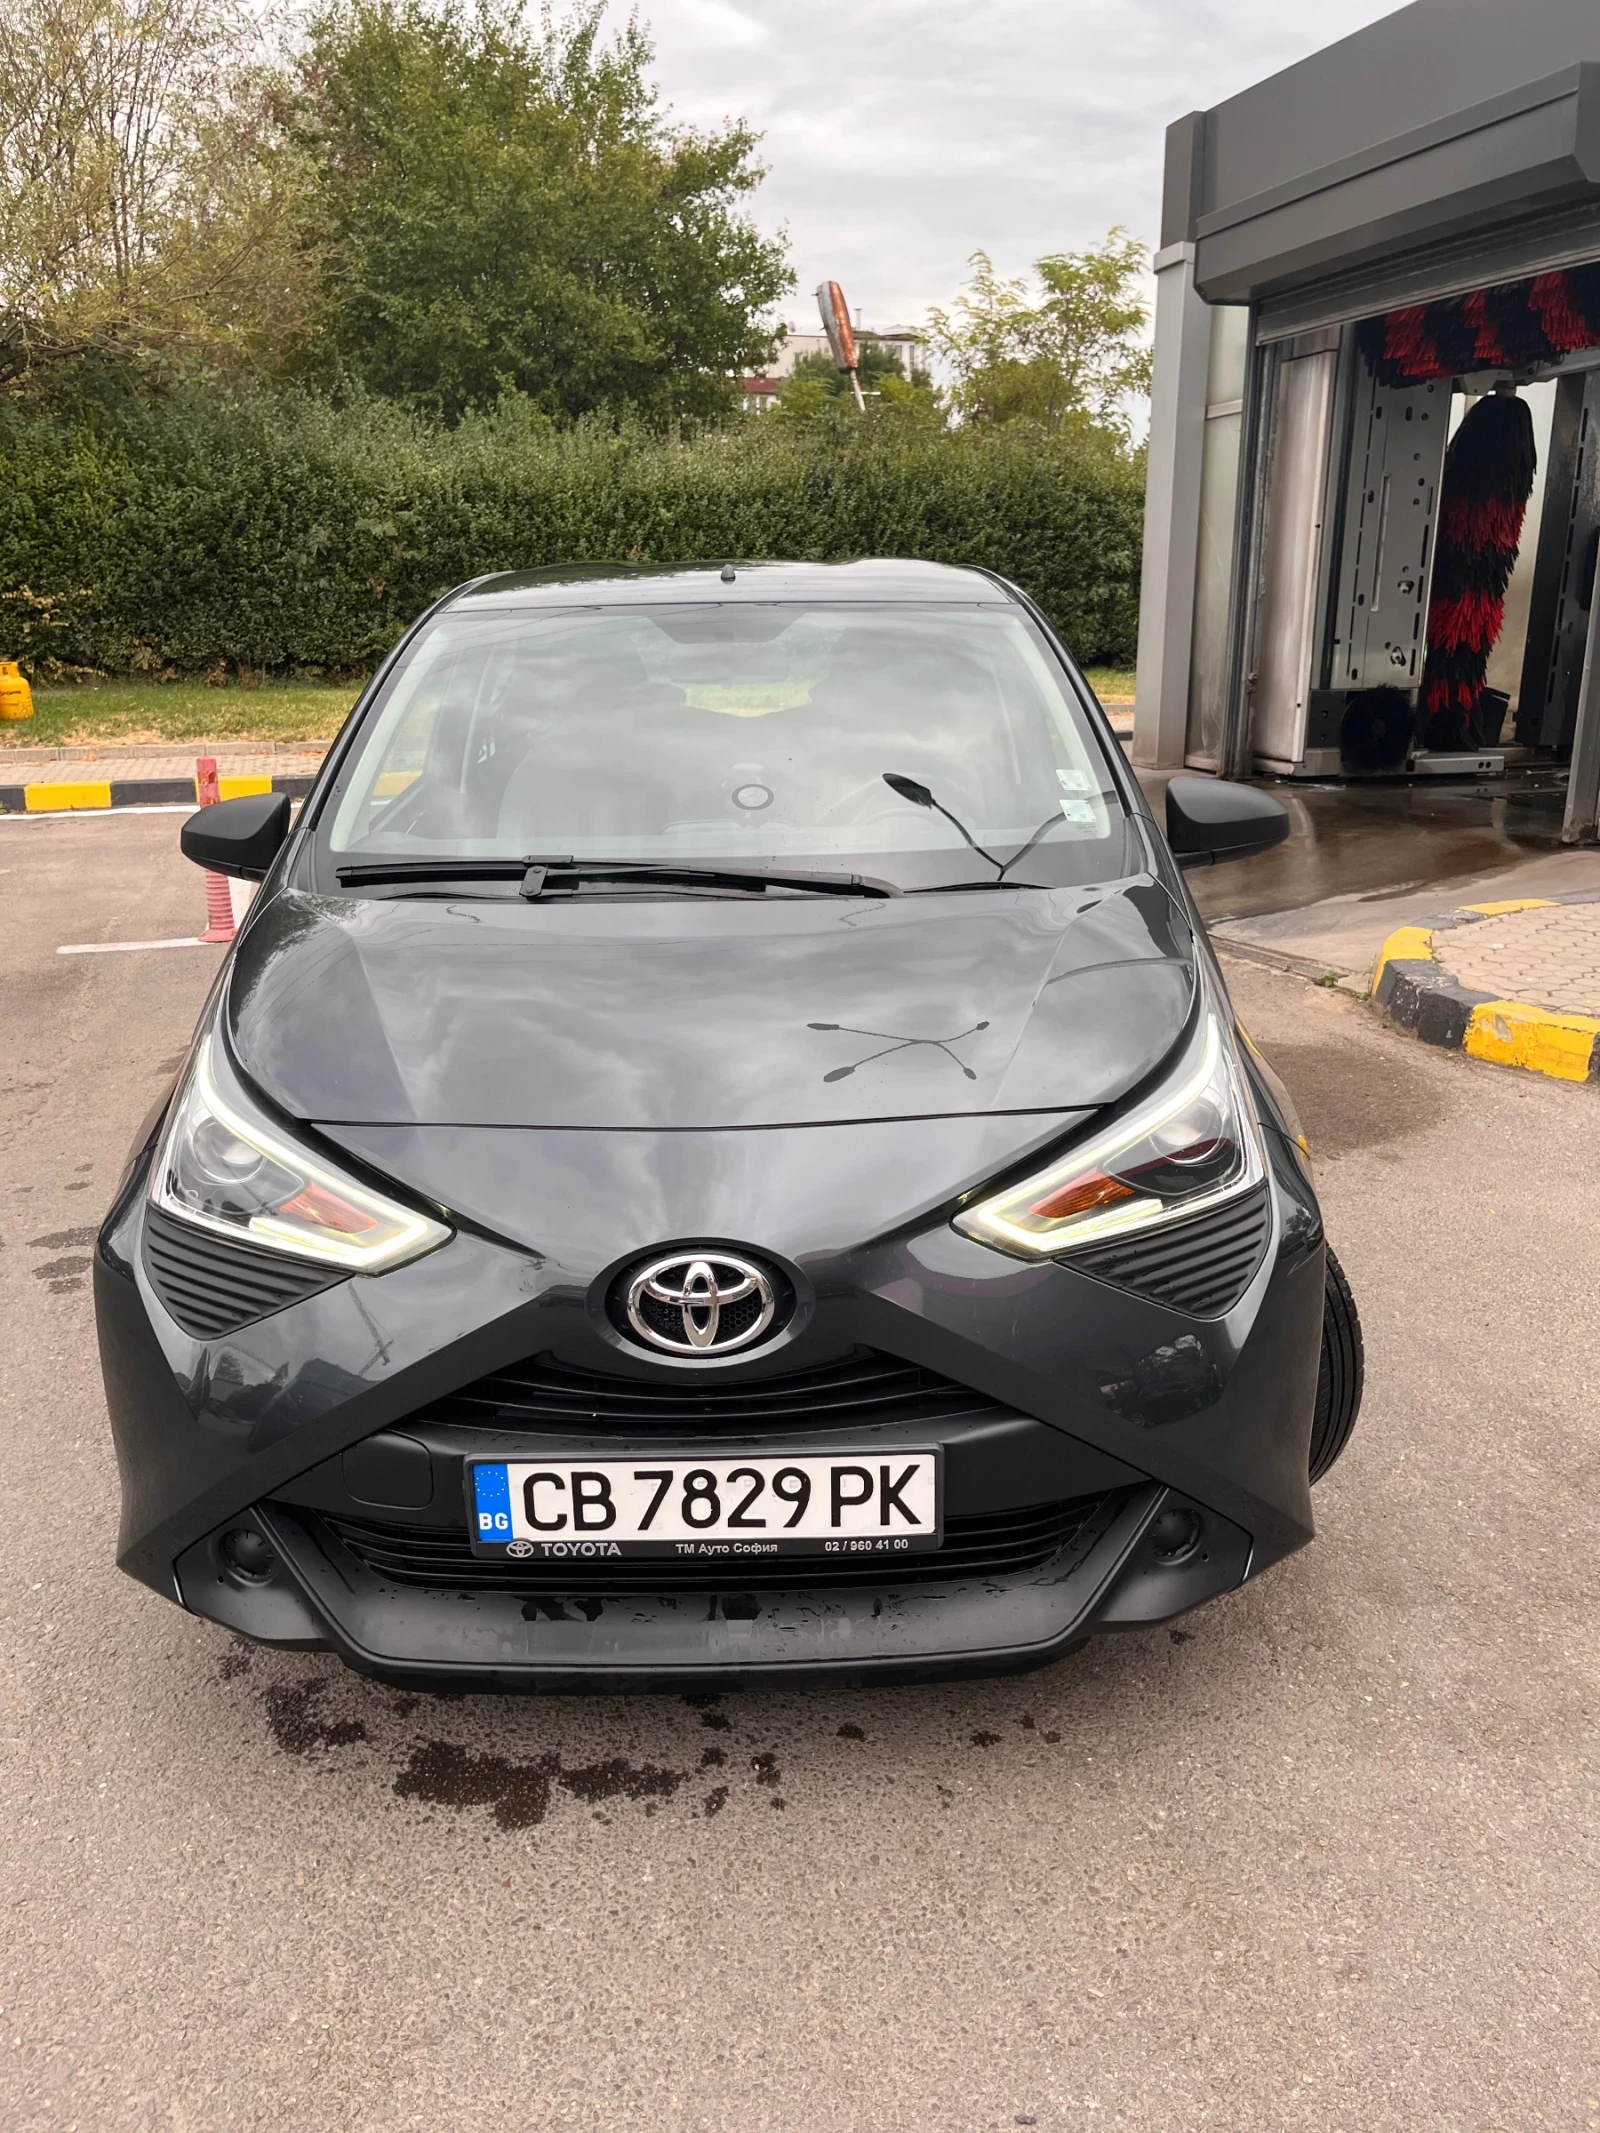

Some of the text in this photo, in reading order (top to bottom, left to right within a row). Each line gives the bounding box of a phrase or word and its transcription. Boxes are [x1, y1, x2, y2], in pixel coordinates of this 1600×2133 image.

[522, 1465, 923, 1532] CB 7829 PK
[479, 1513, 508, 1530] BG
[541, 1542, 622, 1557] TOYOTA
[698, 1544, 730, 1556] Ауто
[733, 1543, 778, 1555] София
[824, 1541, 840, 1551] 02
[850, 1540, 873, 1551] 960
[875, 1540, 890, 1550] 41
[893, 1539, 909, 1549] 00
